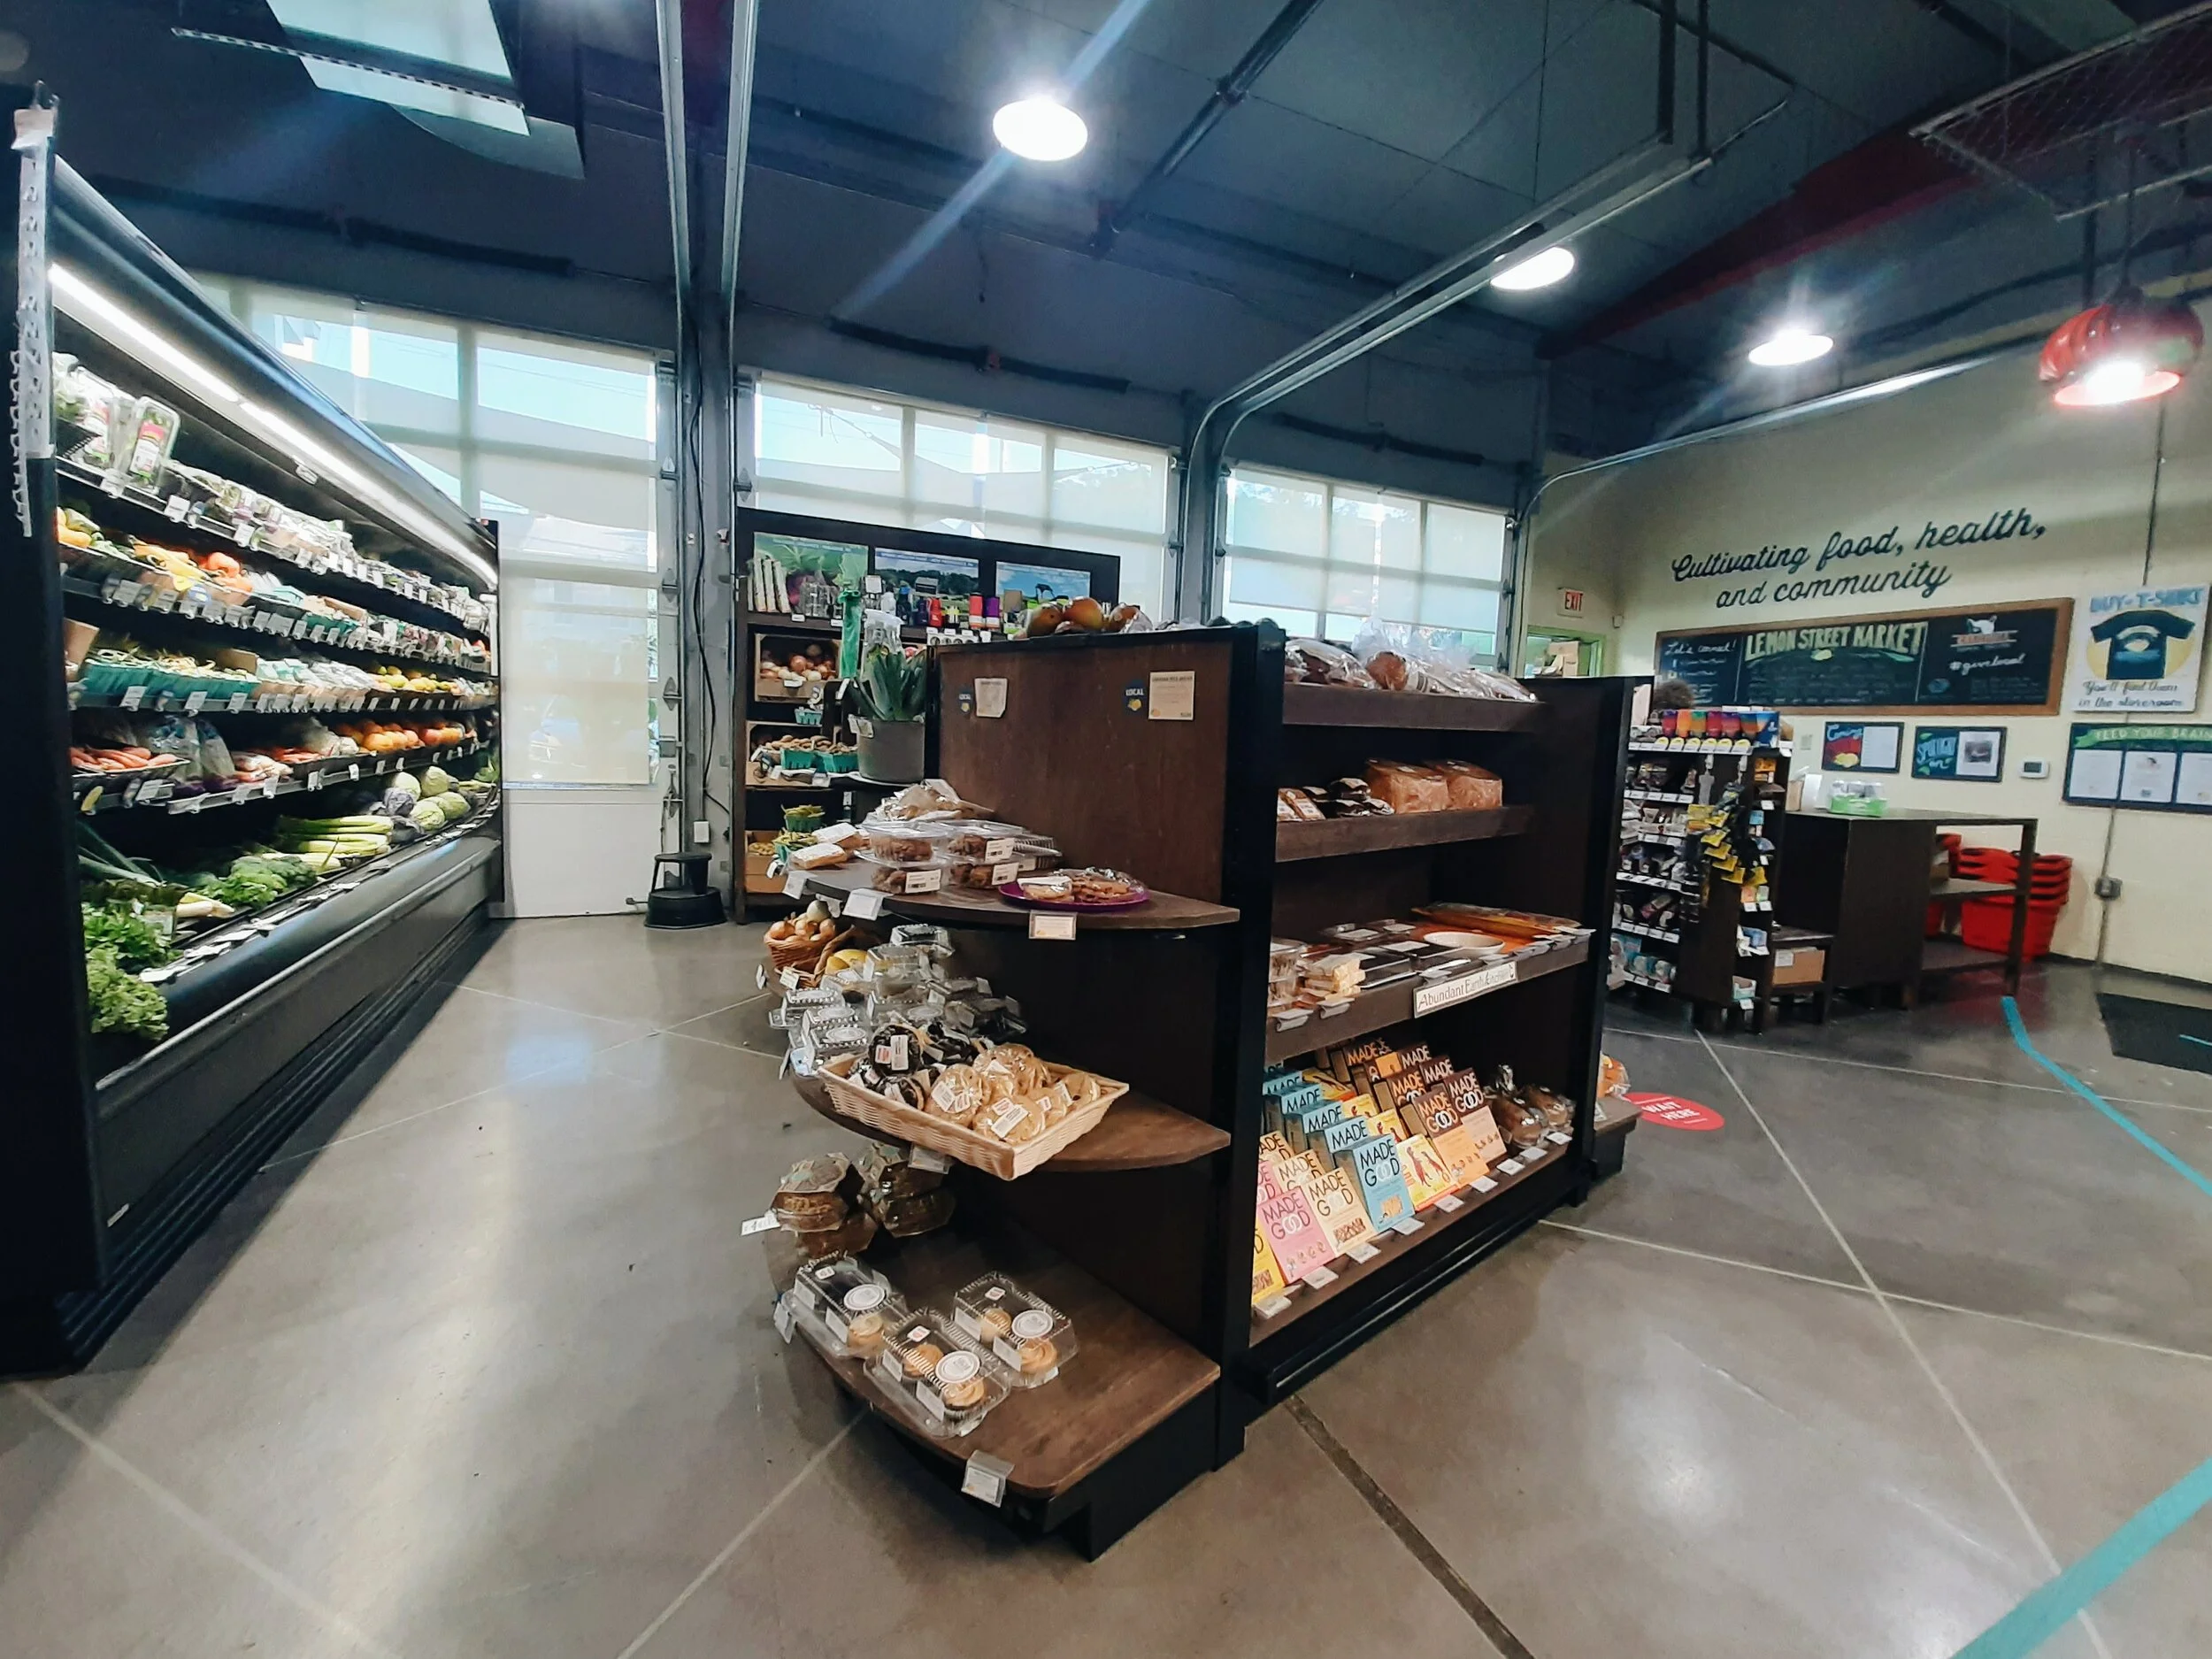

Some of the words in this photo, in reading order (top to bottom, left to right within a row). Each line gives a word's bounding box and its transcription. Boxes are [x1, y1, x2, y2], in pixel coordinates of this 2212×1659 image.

[1671, 545, 1810, 582] Cultivating
[1816, 526, 1904, 572] food,
[1915, 508, 2046, 550] health,
[1716, 580, 1768, 608] and
[1773, 560, 1952, 602] community
[1564, 591, 1584, 611] EXIT
[1745, 630, 1796, 662] LEMON
[1798, 626, 1851, 649] STREET
[1853, 622, 1929, 655] MARKET
[1417, 985, 1464, 1010] Abundant
[1348, 1043, 1379, 1065] MADE
[1402, 1045, 1432, 1070] MADE
[1391, 1071, 1424, 1097] MADE
[1425, 1058, 1454, 1083] MADE
[1448, 1071, 1480, 1099] MADE
[1417, 1091, 1452, 1119] MADE
[1455, 1088, 1484, 1113] GOOD
[1426, 1106, 1458, 1133] GOOD
[1259, 1133, 1285, 1155] ADE
[1332, 1120, 1368, 1149] MADE
[1279, 1153, 1317, 1181] MADE
[1360, 1139, 1395, 1170] MADE
[1364, 1157, 1400, 1187] GOOD
[1309, 1171, 1347, 1202] MADE
[1263, 1193, 1303, 1225] MADE
[1317, 1188, 1353, 1217] GOOD
[1271, 1210, 1310, 1240] GOOD
